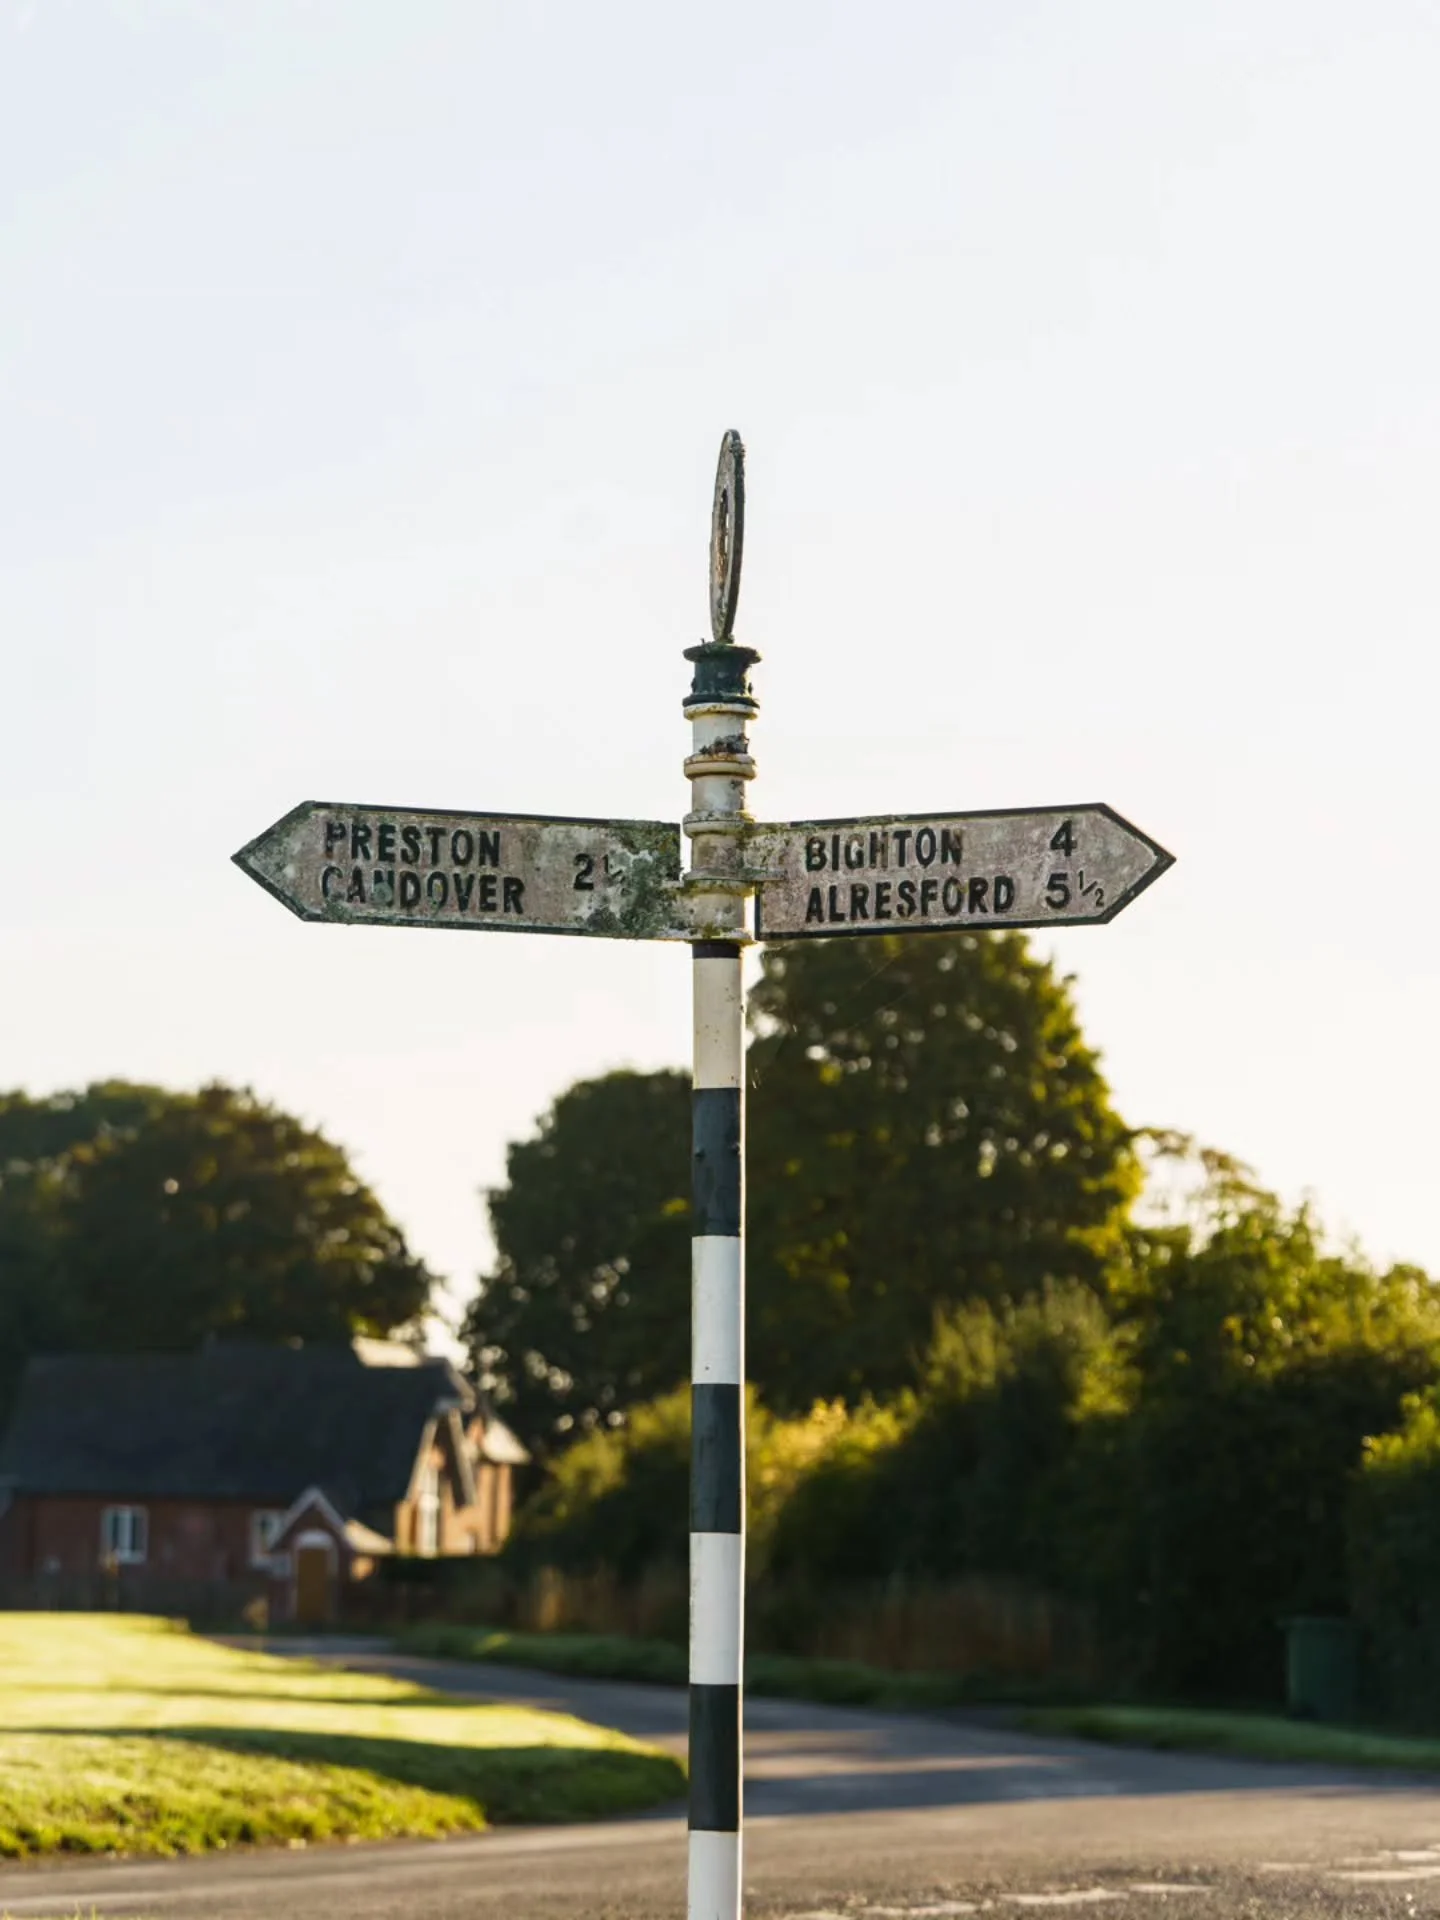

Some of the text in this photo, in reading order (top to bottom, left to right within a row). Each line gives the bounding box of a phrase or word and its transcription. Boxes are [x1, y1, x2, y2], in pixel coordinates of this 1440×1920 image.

[324, 821, 501, 867] PRESTON
[805, 820, 1078, 872] BIGHTON 4
[322, 865, 526, 915] CANDOVER
[805, 875, 1015, 923] ALRESFORD
